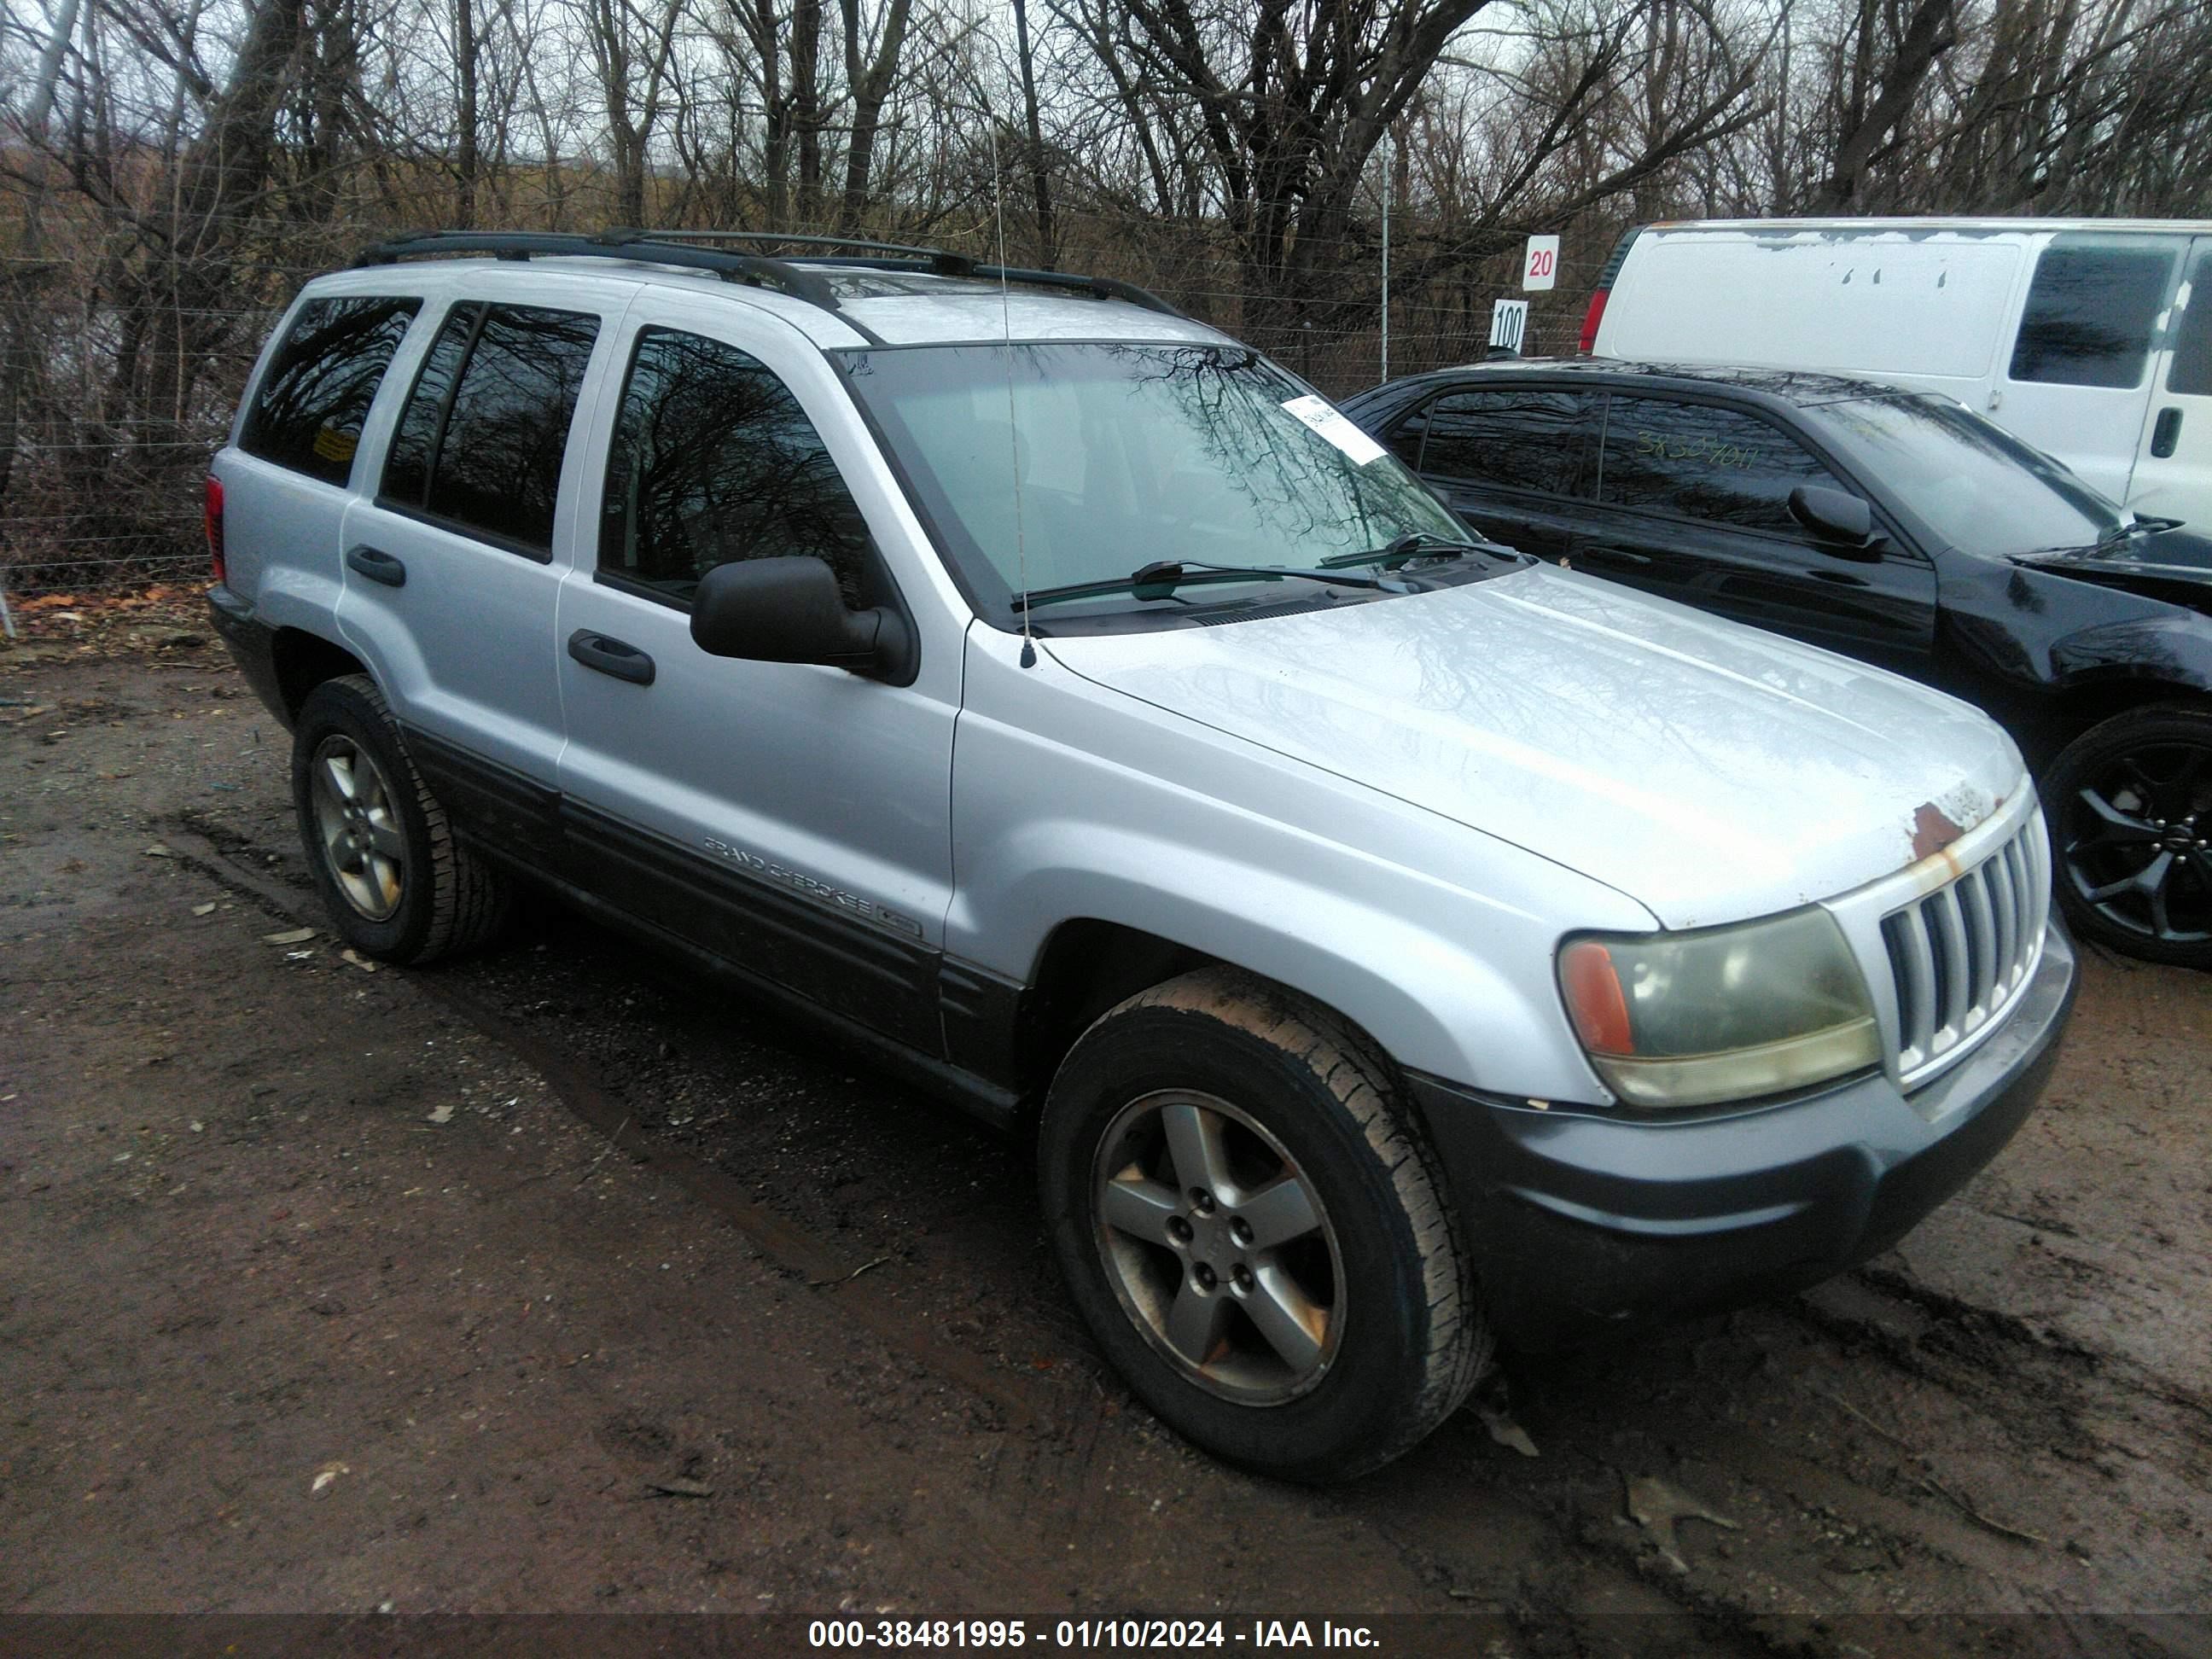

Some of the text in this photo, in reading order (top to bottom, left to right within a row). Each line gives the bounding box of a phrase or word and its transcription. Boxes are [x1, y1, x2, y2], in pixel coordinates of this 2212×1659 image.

[1529, 250, 1552, 276] 20
[1497, 306, 1522, 348] 100
[705, 836, 871, 914] GRAND CHEROKEE
